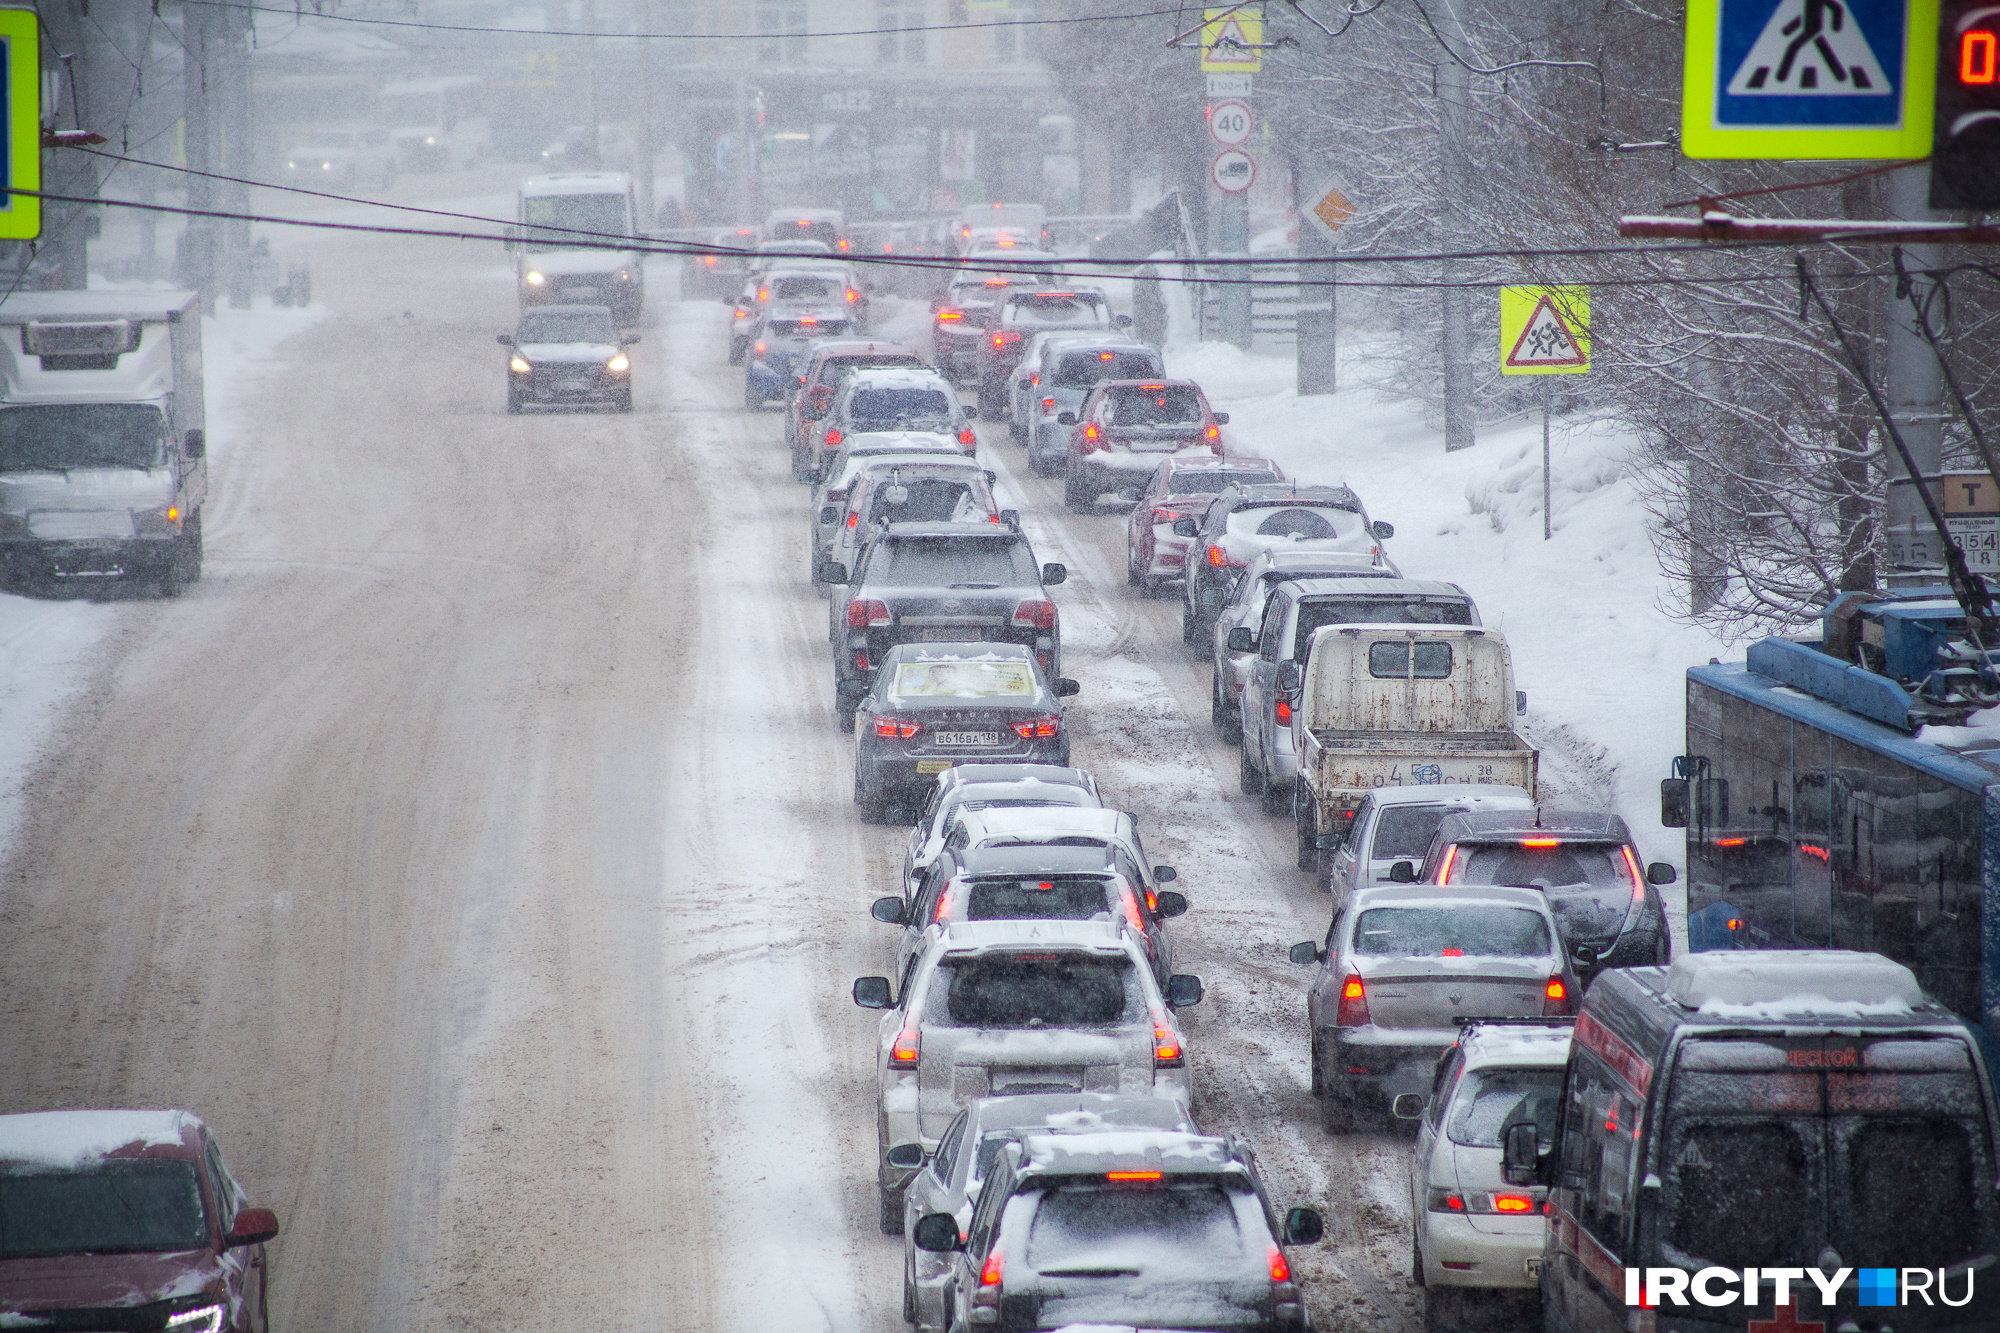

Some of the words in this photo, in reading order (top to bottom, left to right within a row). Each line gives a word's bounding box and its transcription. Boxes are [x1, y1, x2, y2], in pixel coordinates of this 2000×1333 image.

[1218, 114, 1244, 132] 40
[938, 732, 979, 744] В616ВА
[981, 732, 997, 741] 138
[1477, 764, 1493, 776] 38
